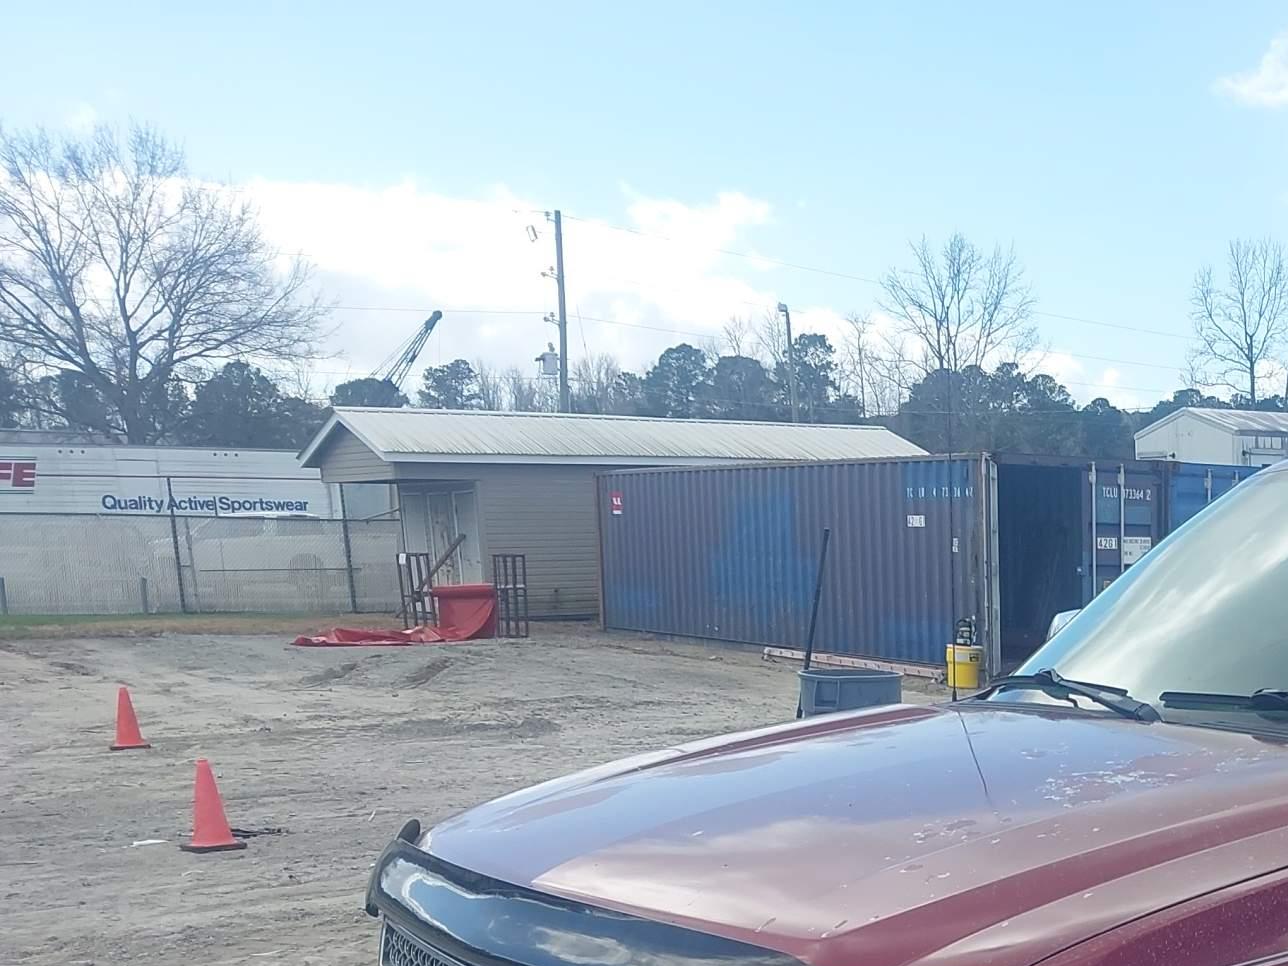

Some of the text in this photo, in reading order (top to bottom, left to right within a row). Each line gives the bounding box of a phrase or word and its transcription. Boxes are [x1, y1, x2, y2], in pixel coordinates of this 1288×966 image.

[1102, 487, 1118, 498] TCLU
[102, 494, 309, 513] Quality Active Sportswear
